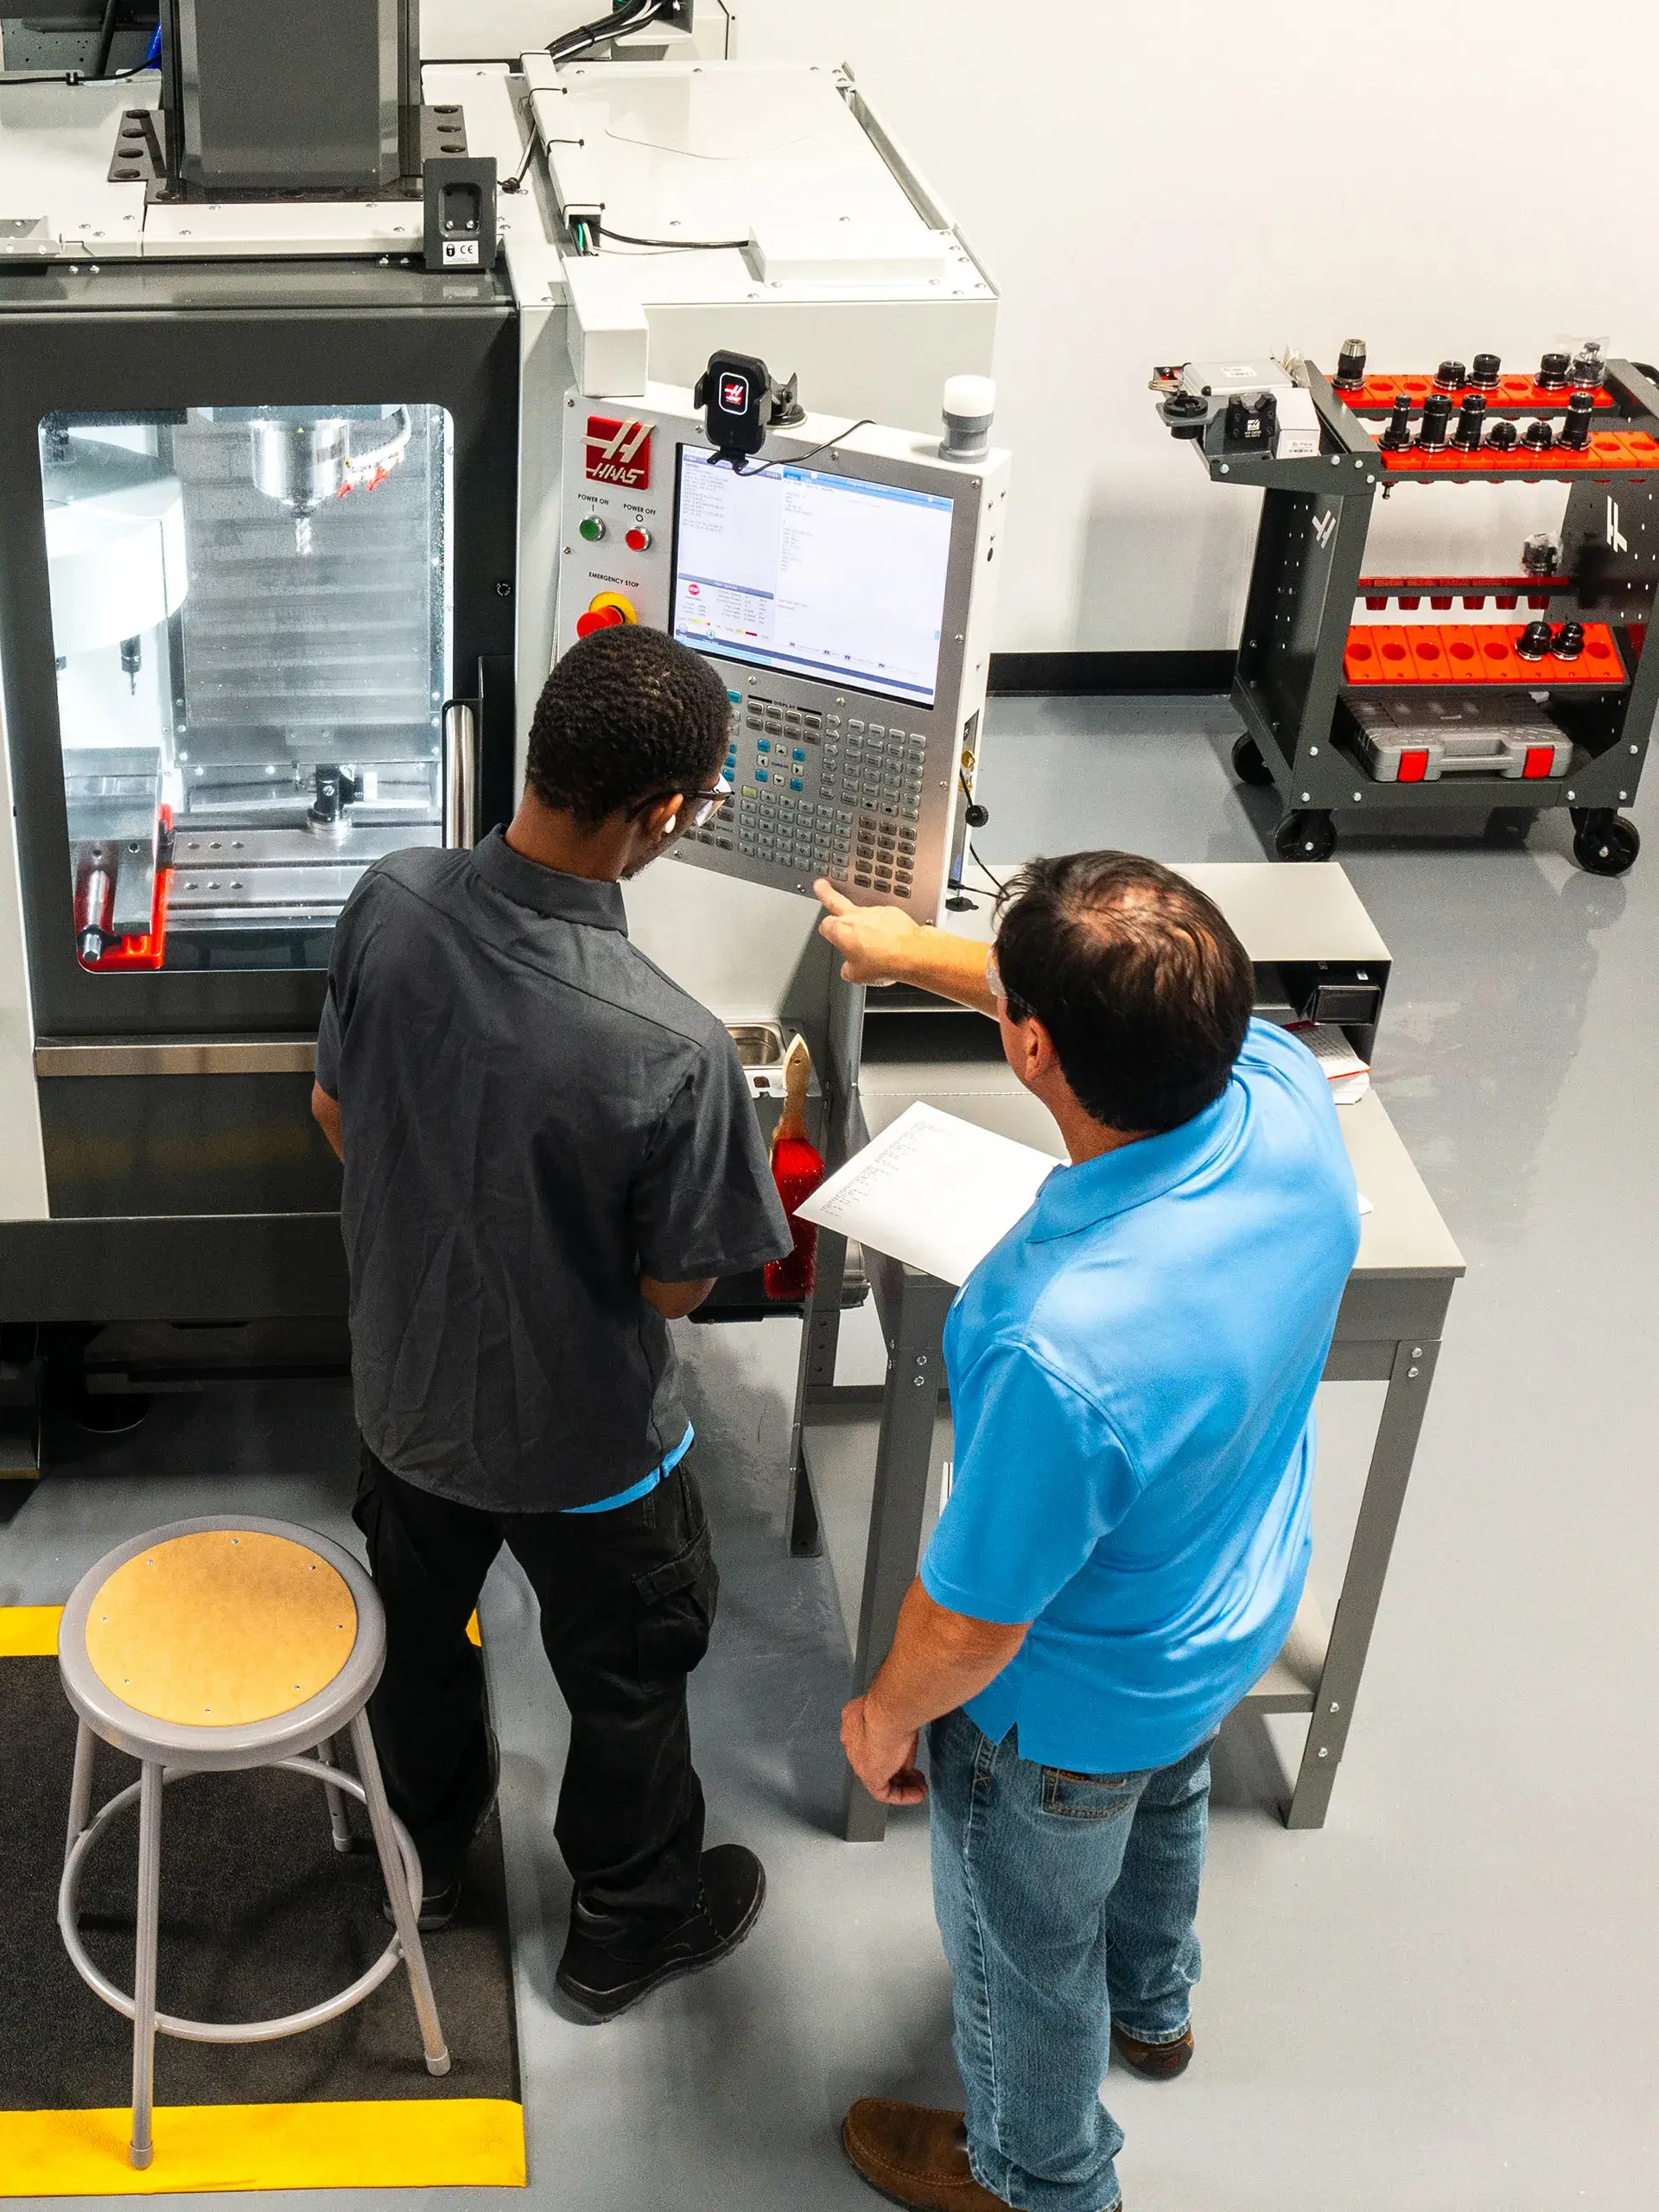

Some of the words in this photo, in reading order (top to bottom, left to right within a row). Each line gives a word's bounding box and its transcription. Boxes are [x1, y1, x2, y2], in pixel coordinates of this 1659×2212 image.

[460, 245, 474, 255] CE
[586, 462, 645, 485] HAAS
[577, 493, 598, 503] POWER
[623, 504, 644, 512] POWER
[588, 572, 624, 584] EMERGENCY
